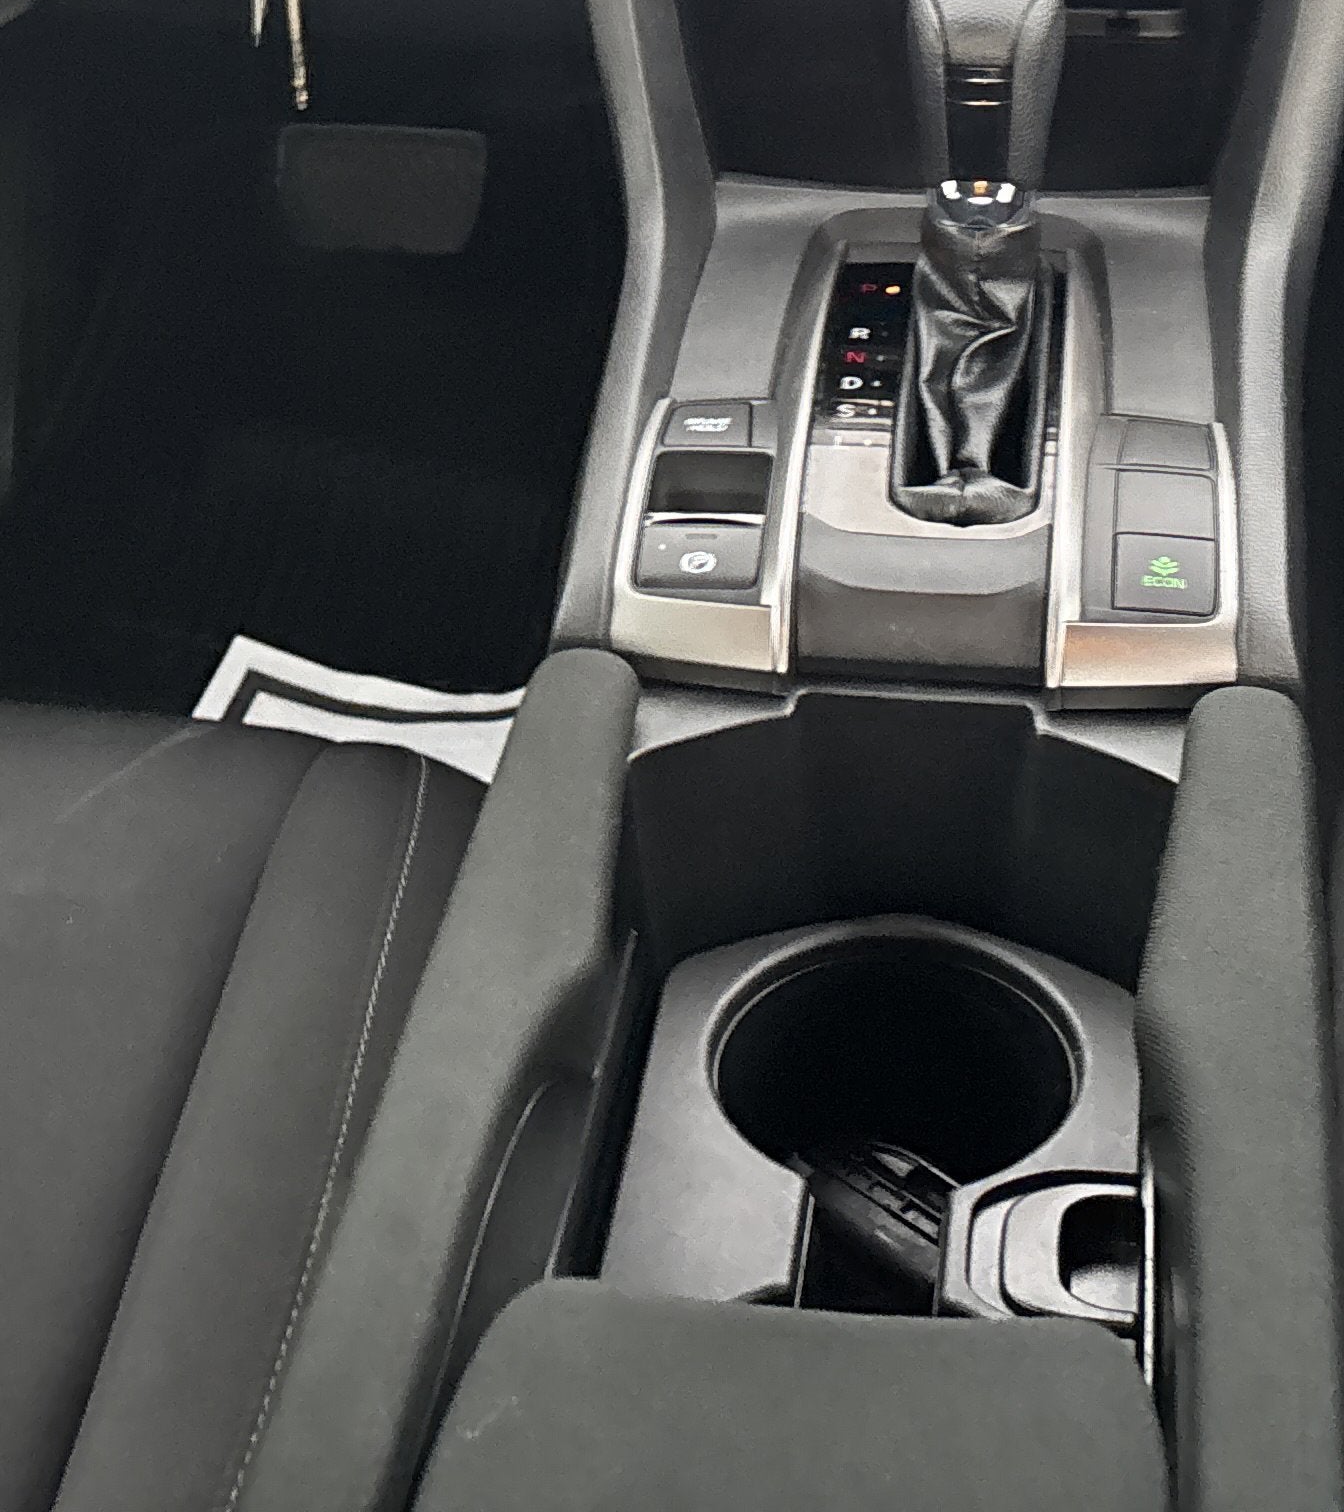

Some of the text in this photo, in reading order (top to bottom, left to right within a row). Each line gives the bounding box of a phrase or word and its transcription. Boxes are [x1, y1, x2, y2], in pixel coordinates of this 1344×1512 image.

[849, 327, 871, 340] R
[844, 351, 867, 363] N
[840, 376, 864, 390] D
[835, 404, 857, 418] S
[1142, 575, 1186, 590] ECON
